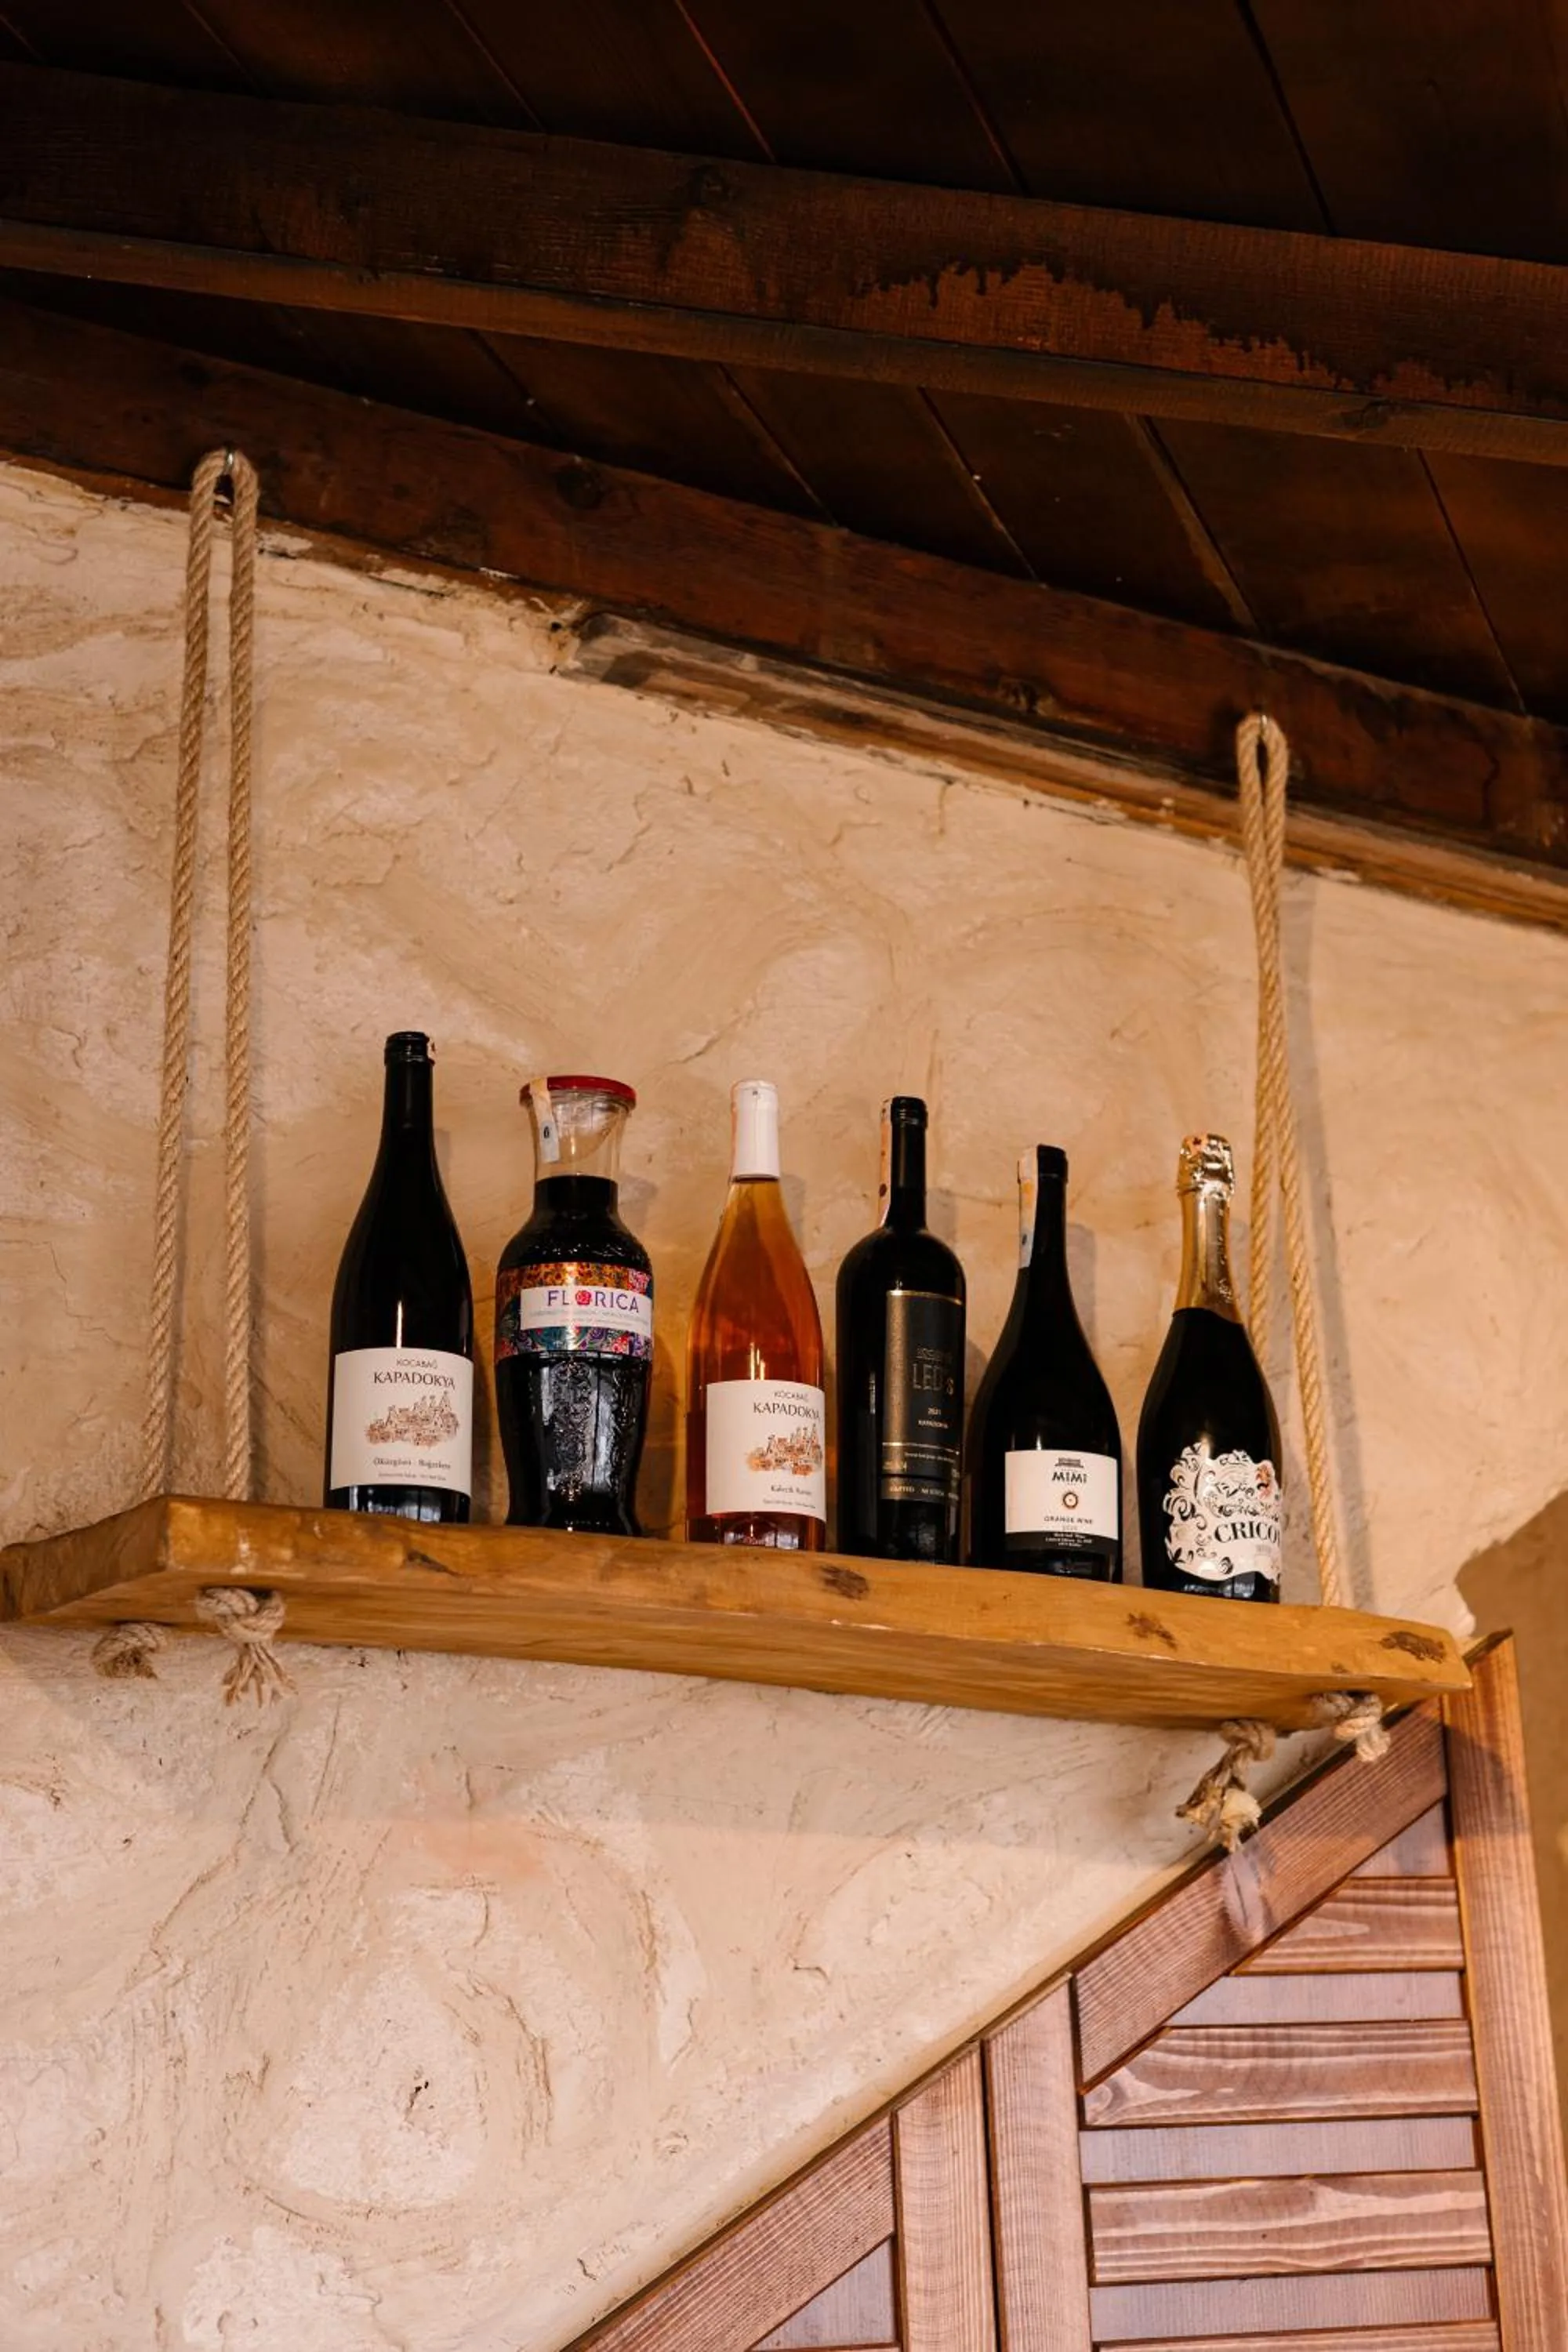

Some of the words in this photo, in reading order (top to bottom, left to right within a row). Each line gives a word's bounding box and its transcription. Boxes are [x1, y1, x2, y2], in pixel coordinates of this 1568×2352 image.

[547, 1290, 640, 1313] FLORICA
[373, 1371, 456, 1391] KAPADOKYA
[1051, 1472, 1087, 1484] MIMI
